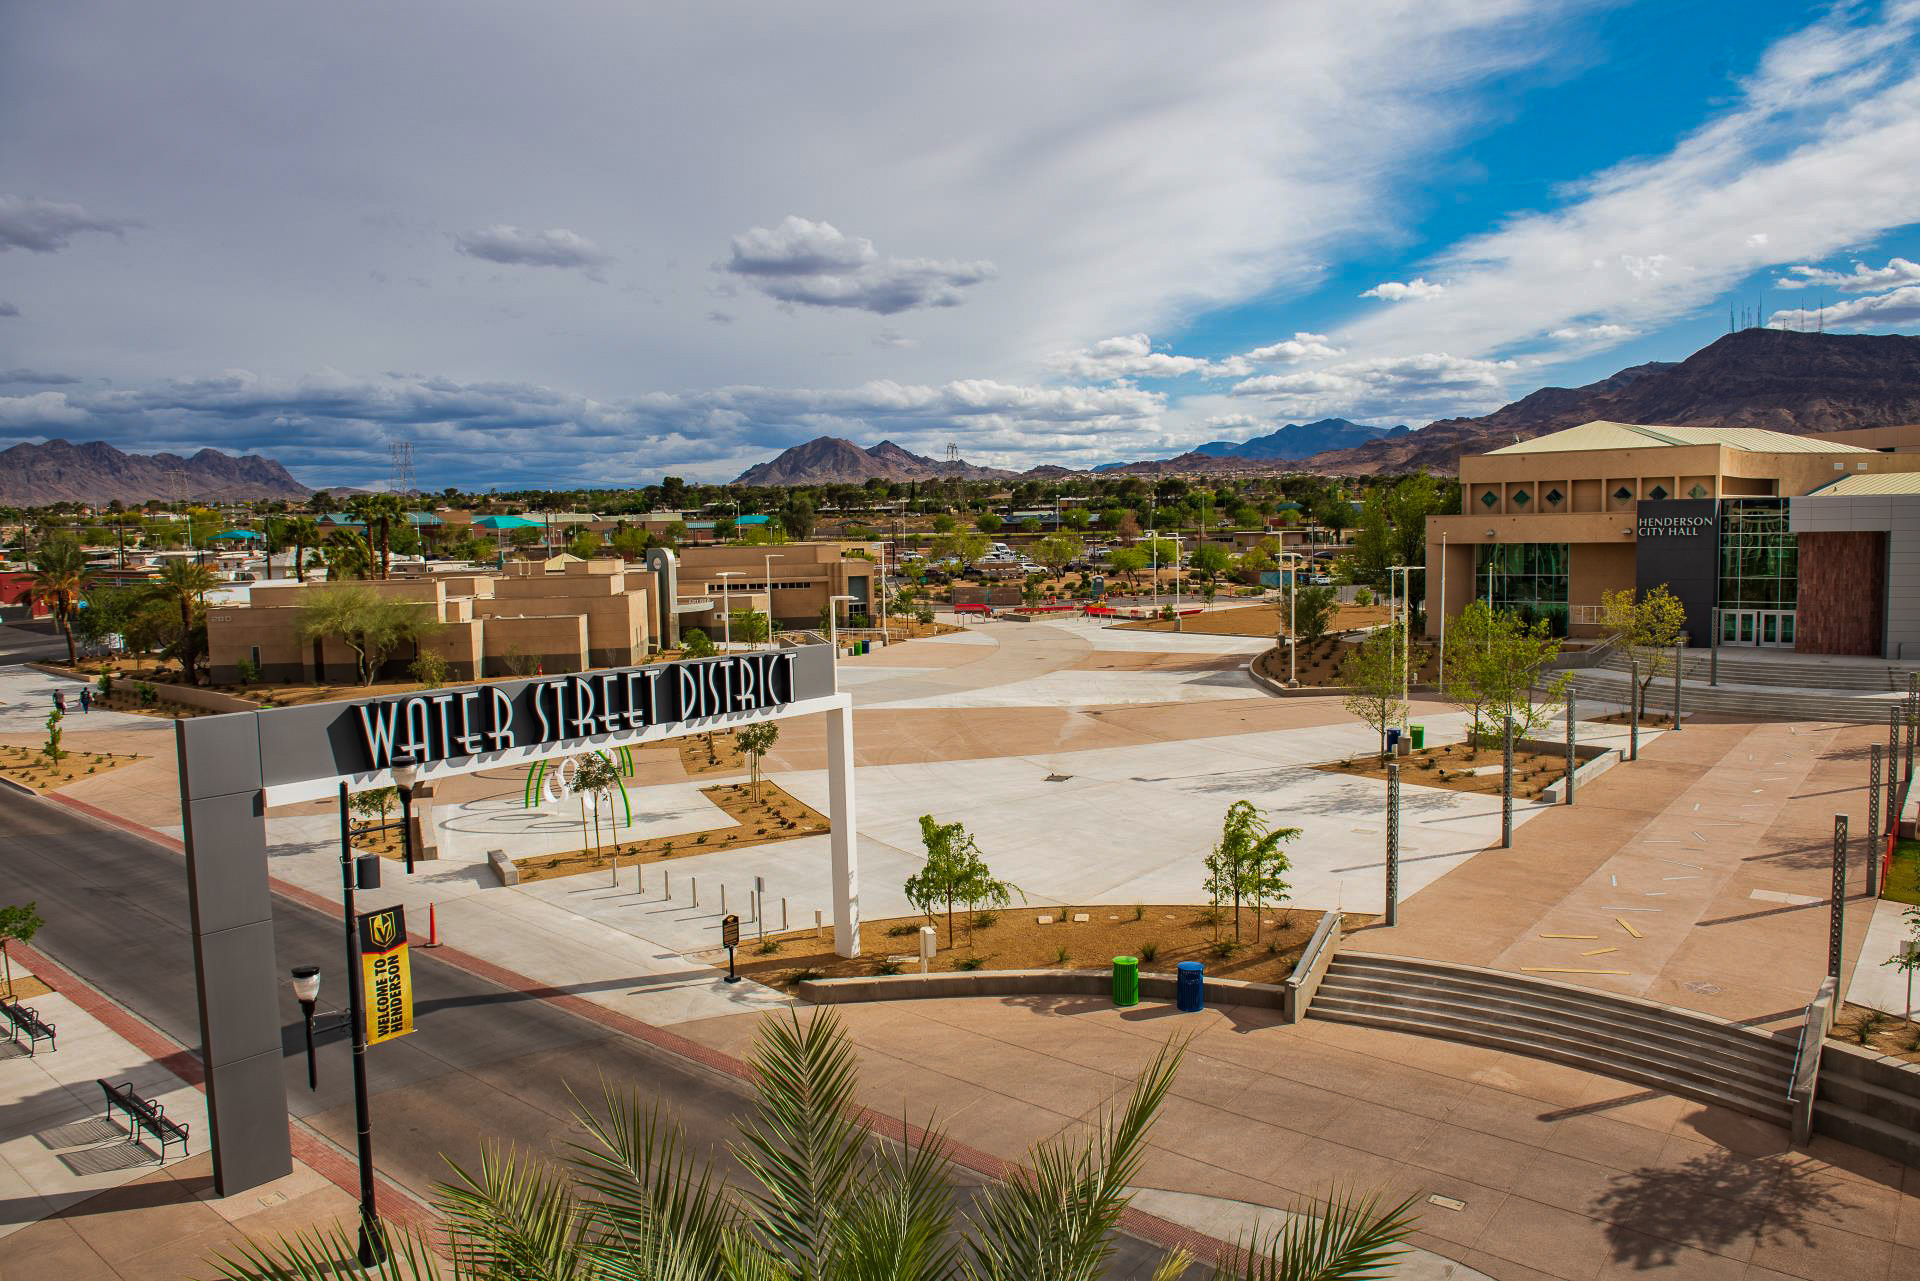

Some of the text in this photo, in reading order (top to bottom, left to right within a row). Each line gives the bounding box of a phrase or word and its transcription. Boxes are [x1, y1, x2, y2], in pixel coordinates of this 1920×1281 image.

[1639, 517, 1713, 527] HENDERSON
[1639, 527, 1699, 537] CITY HALL
[361, 653, 797, 769] WATER STREET DISTRICT
[374, 958, 390, 1039] WELCOME TO
[387, 954, 403, 1034] HENDERSON
